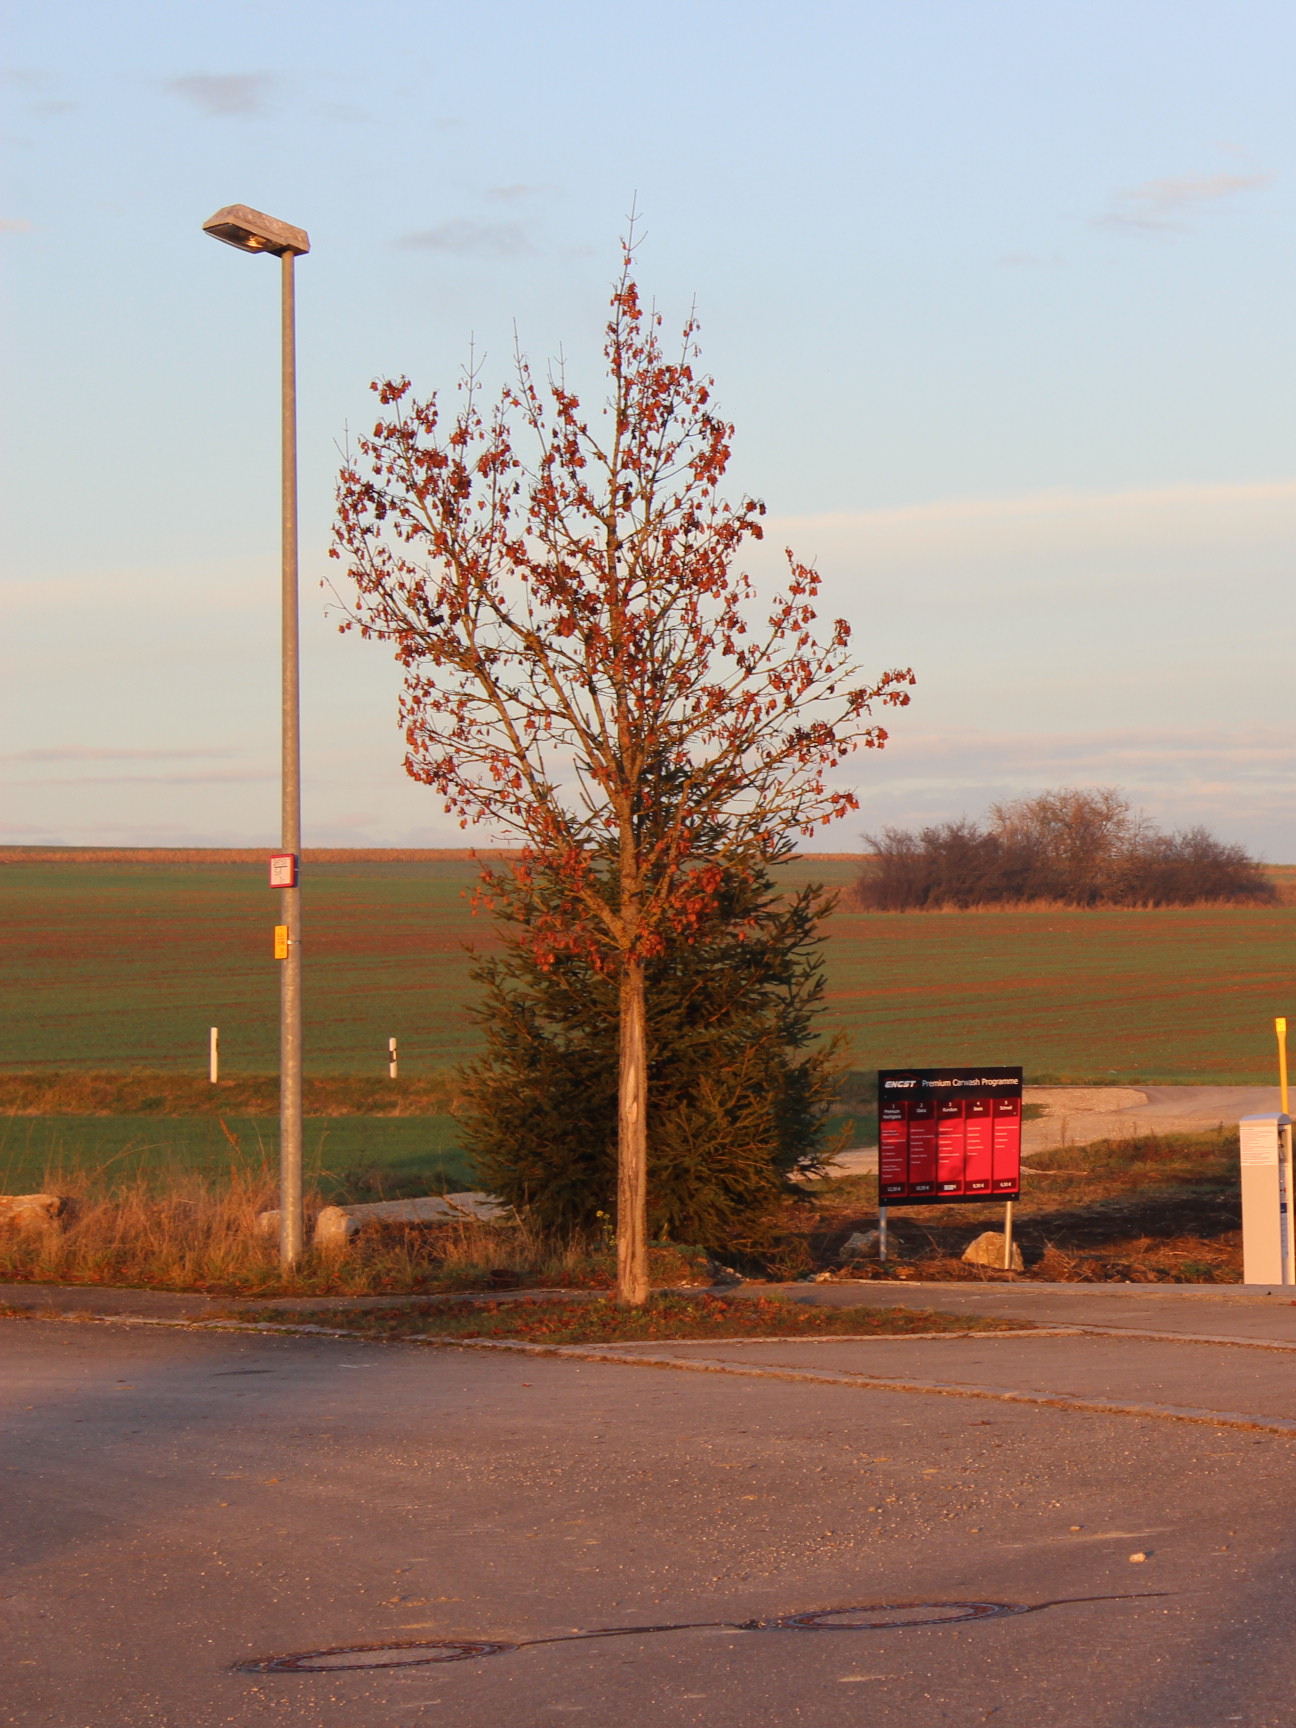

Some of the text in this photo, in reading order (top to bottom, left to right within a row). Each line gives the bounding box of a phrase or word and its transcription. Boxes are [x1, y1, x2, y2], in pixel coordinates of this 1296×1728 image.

[885, 1078, 1019, 1088] ENGST Premium Carwash Programme
